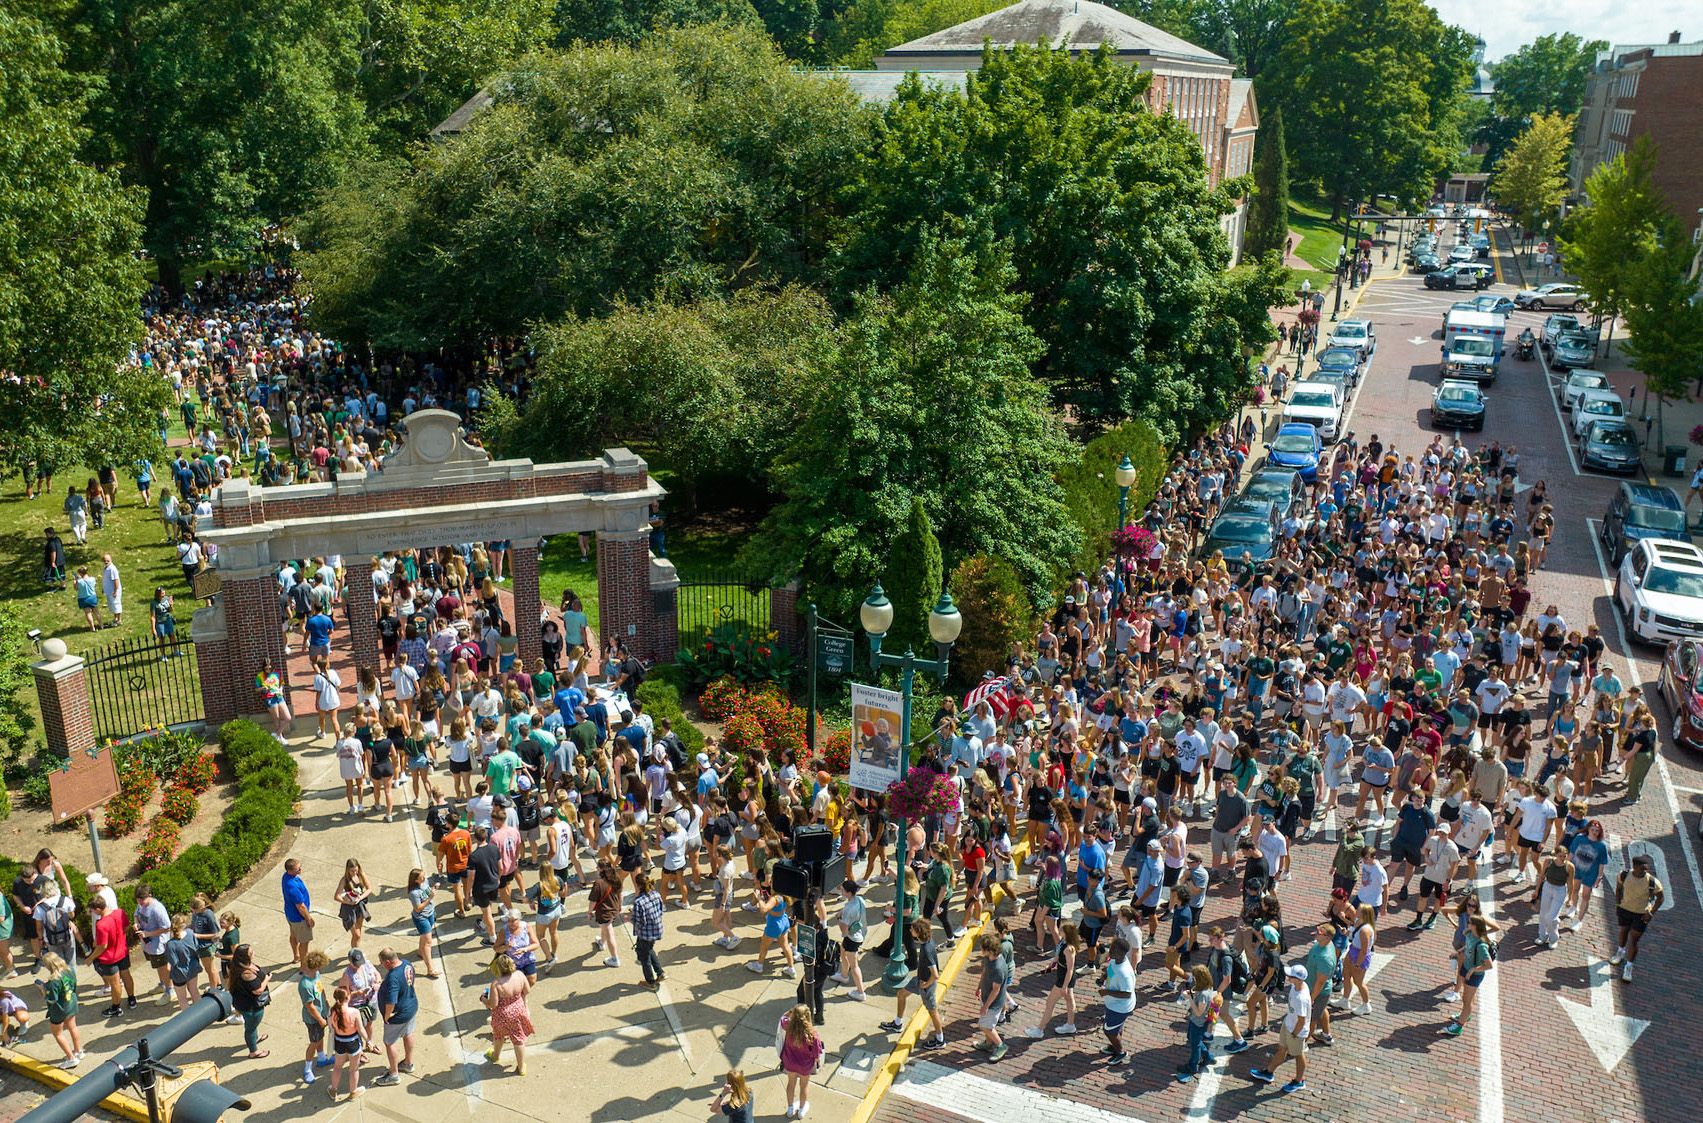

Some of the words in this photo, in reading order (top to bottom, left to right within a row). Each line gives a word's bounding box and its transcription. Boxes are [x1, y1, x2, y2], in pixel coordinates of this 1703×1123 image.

[378, 531, 397, 539] ENTER
[440, 526, 456, 534] THOU
[386, 537, 428, 546] KNOWLEDGE
[432, 533, 460, 541] WISDOM
[465, 531, 478, 539] AND
[824, 639, 846, 648] College
[825, 646, 844, 654] Green
[856, 688, 877, 697] Foster
[878, 692, 899, 702] bright
[865, 698, 890, 710] futures.
